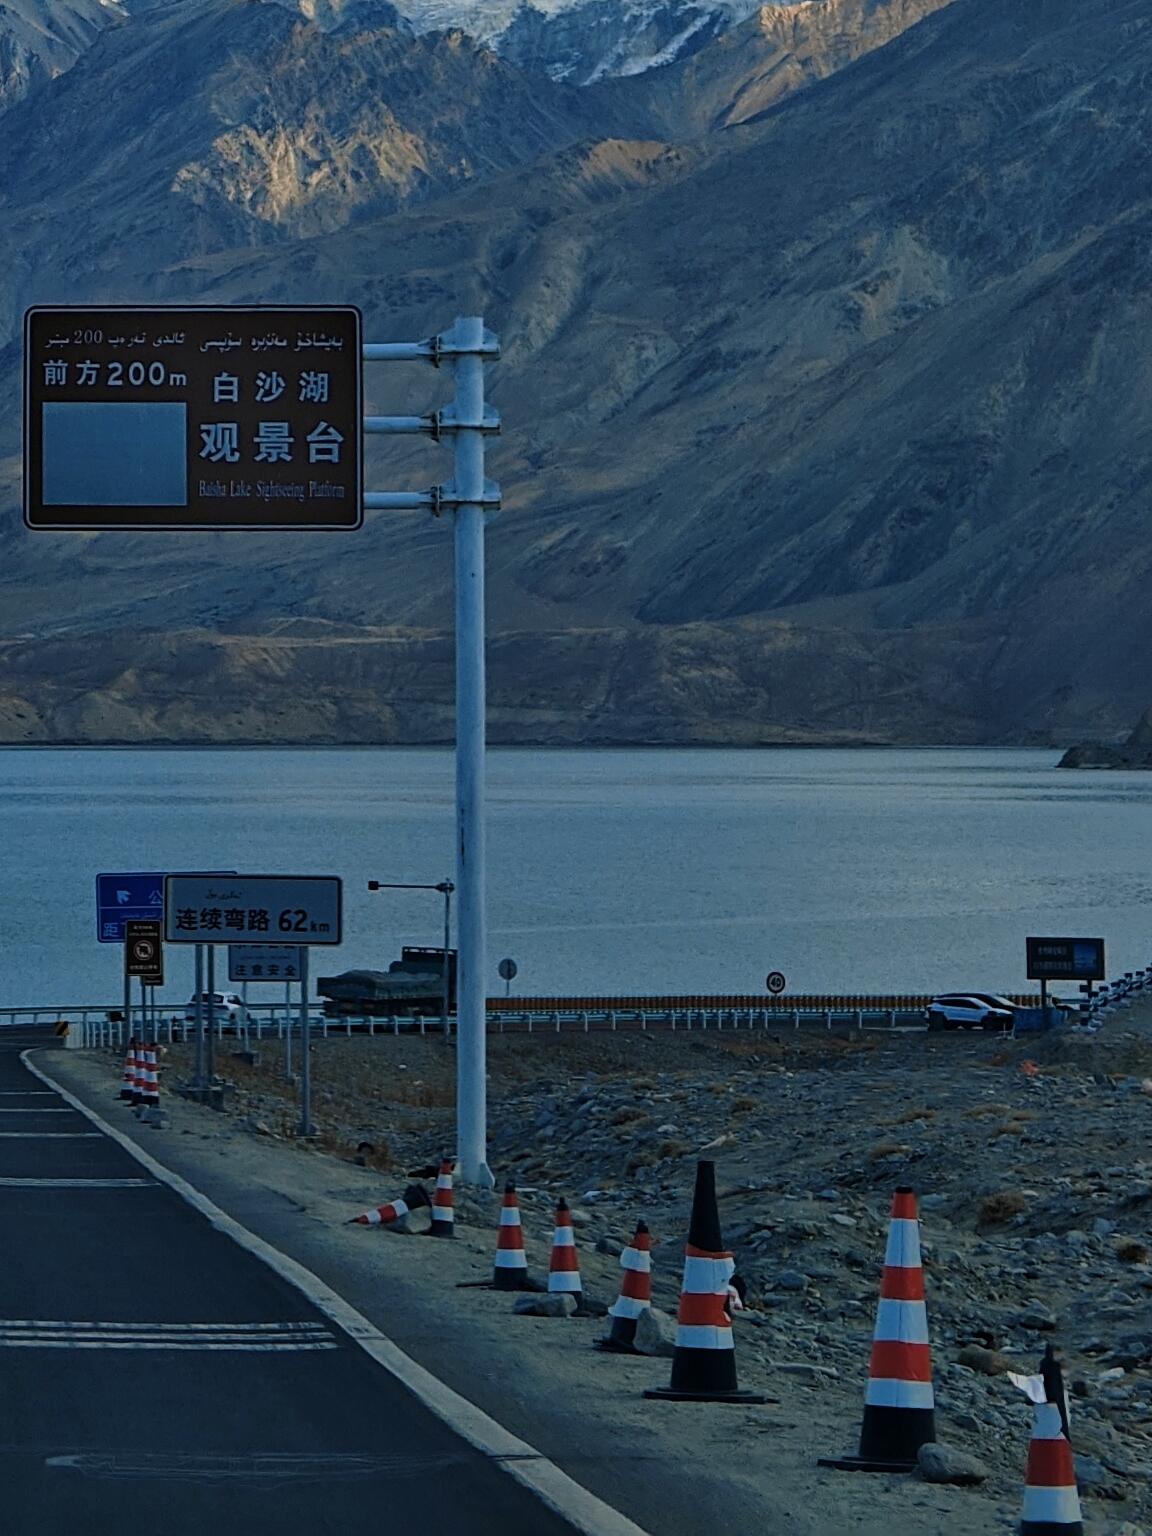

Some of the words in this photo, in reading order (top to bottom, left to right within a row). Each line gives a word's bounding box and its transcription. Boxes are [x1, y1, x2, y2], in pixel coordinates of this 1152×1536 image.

[73, 329, 104, 345] 200
[42, 359, 187, 387] 前方200m
[211, 371, 330, 404] 白沙湖
[199, 420, 345, 464] 观景台
[199, 479, 227, 497] Baisha
[230, 479, 251, 497] Lake
[256, 479, 305, 502] Sightseeing
[308, 479, 345, 498] Platform
[175, 907, 271, 932] 连续弯路
[278, 908, 330, 932] 62km
[234, 964, 297, 977] 注意安全
[771, 977, 781, 987] 40
